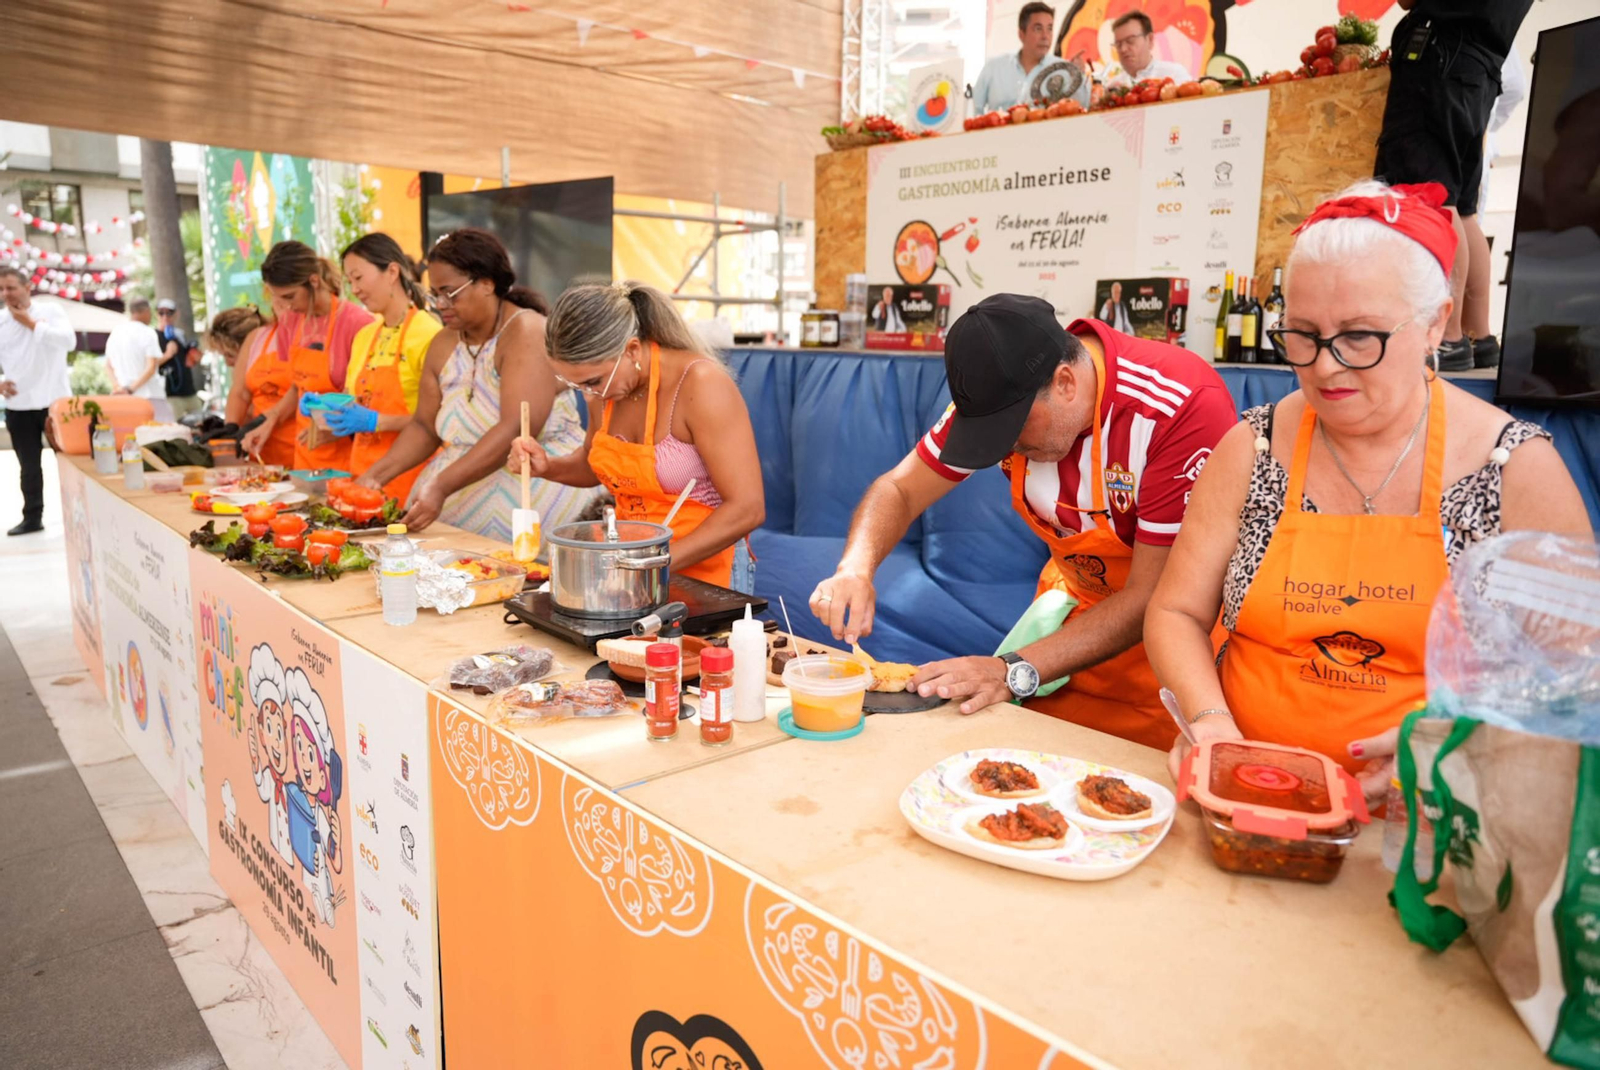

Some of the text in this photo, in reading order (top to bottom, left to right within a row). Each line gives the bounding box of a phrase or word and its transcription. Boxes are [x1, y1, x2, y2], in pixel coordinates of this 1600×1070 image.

[899, 156, 998, 179] III ENCUENTRO DE
[898, 165, 1112, 201] GASTRONOMÍA almeriense
[1157, 202, 1182, 213] eco
[1010, 228, 1086, 251] en FERIA!
[1283, 576, 1415, 602] hogar hotel
[1283, 597, 1342, 615] hoalve
[359, 843, 379, 872] eco
[239, 818, 317, 929] IX CONCURSO DE
[218, 820, 338, 986] GASTRONOMÍA INFANTIL
[270, 912, 291, 945] agosto
